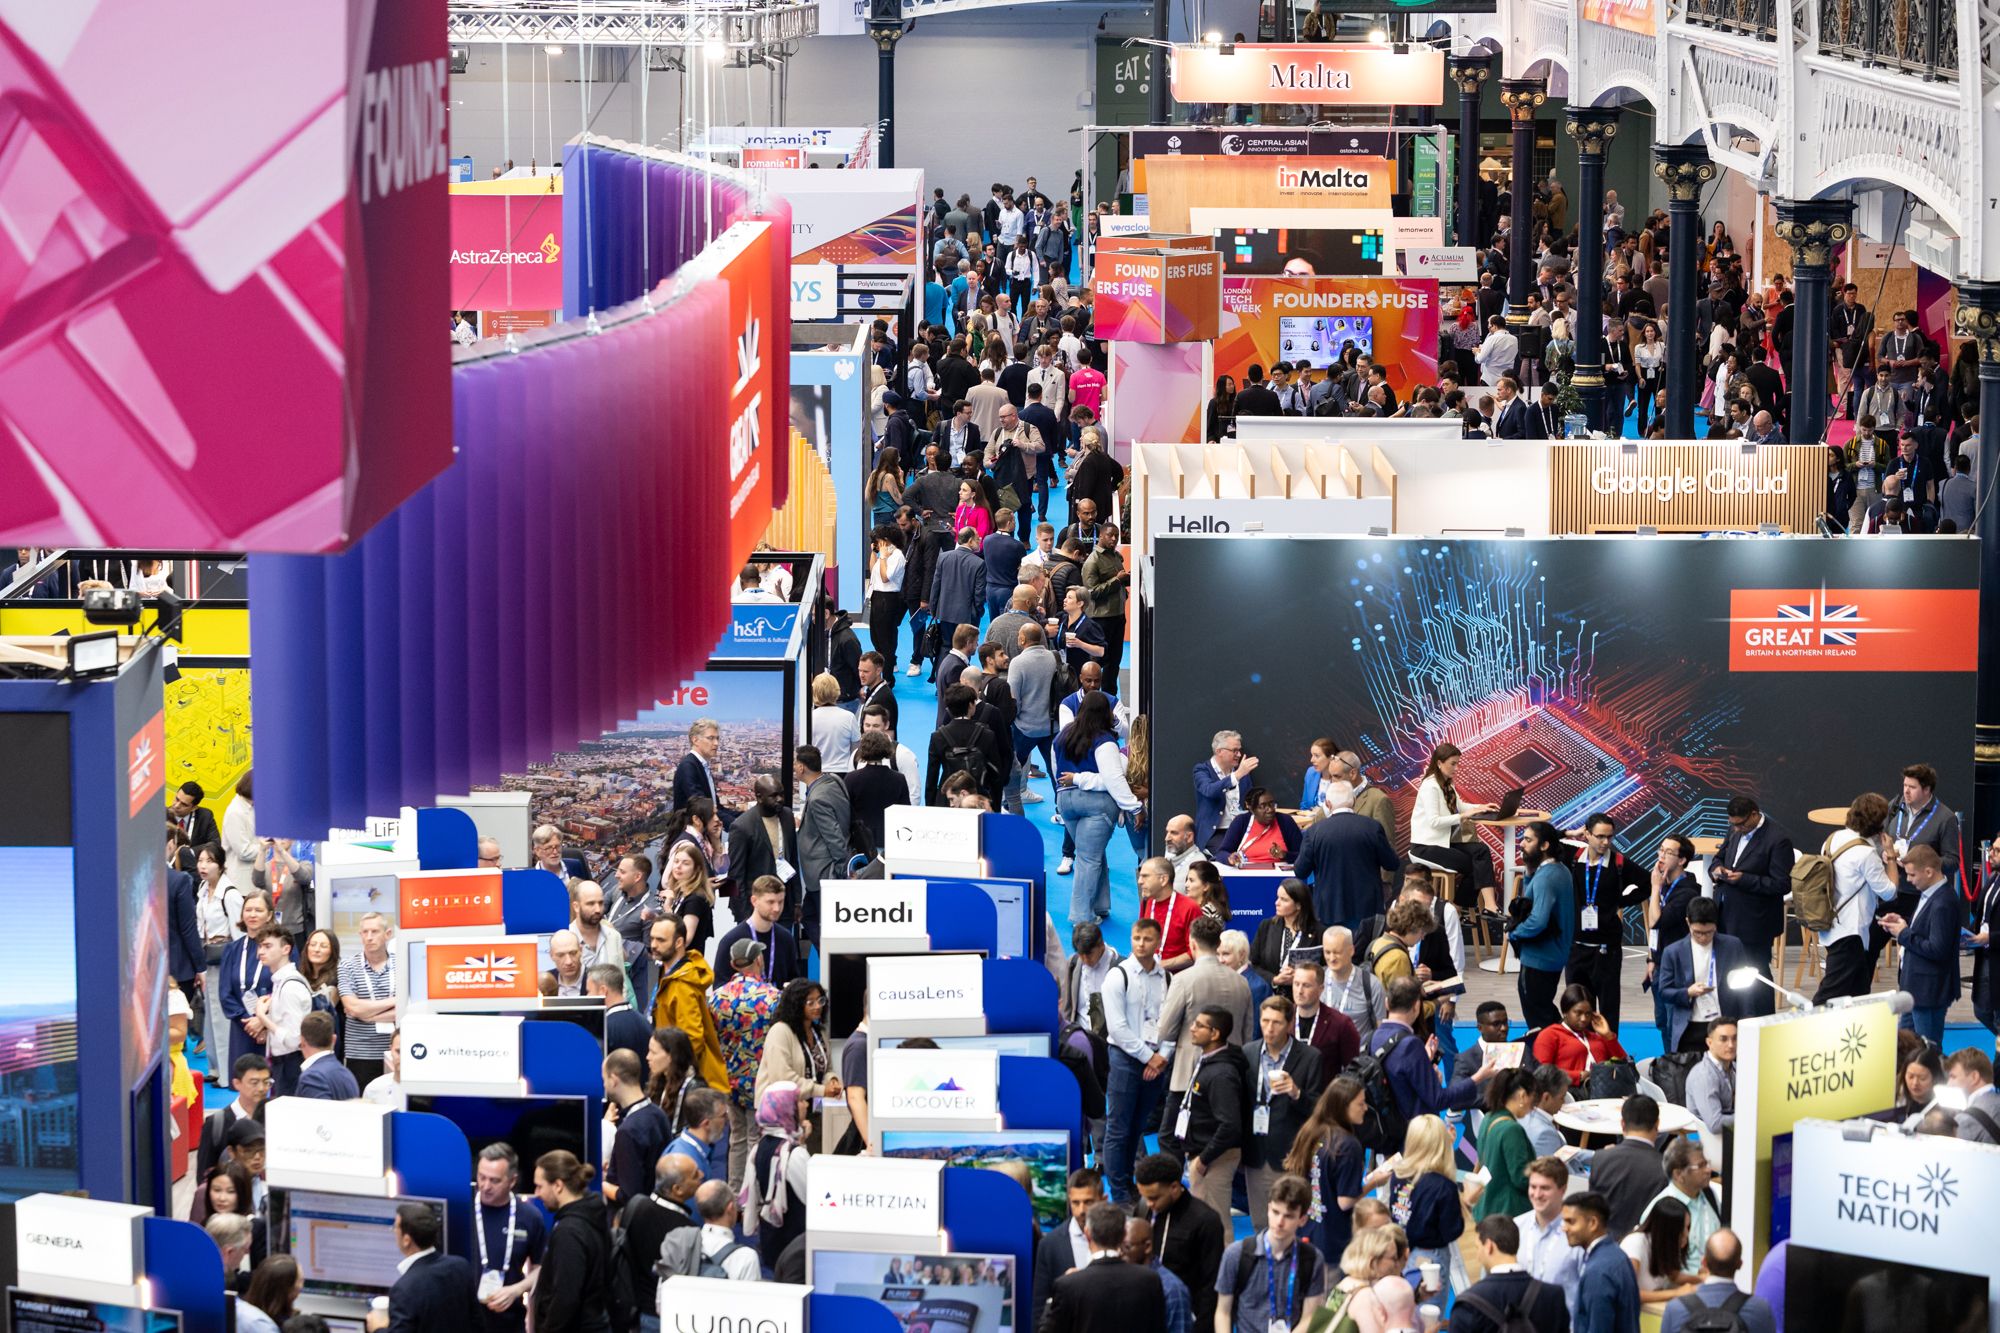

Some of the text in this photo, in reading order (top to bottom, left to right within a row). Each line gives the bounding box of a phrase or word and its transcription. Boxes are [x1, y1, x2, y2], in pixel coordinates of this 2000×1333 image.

[1115, 55, 1140, 81] EAT
[1270, 63, 1351, 89] Malta
[1799, 132, 1807, 142] 6
[1279, 167, 1368, 188] inMalta
[1989, 197, 1998, 210] 7
[449, 249, 543, 264] AstraZeneca
[1115, 263, 1160, 279] FOUND
[1167, 262, 1213, 279] ERS FUSE
[790, 280, 822, 303] YS
[857, 280, 898, 288] PolyVentures
[1096, 281, 1153, 297] ERS FUSE
[1223, 295, 1253, 304] TECH
[1273, 292, 1429, 309] FOUNDERS FUSE
[1231, 304, 1262, 313] WEEK
[1591, 466, 1788, 502] Google Cloud
[1168, 515, 1230, 533] Hello
[733, 620, 766, 637] h&f
[1745, 628, 1814, 646] GREAT
[835, 901, 913, 923] bendi
[445, 970, 489, 983] GREAT
[878, 986, 964, 1001] causaLens
[437, 1046, 510, 1061] whitespace
[1788, 1050, 1836, 1078] TECH
[1786, 1069, 1855, 1101] NATION
[891, 1095, 976, 1109] DXCOVER
[1838, 1173, 1910, 1204] TECH
[842, 1192, 927, 1210] HERTZIAN
[1837, 1198, 1939, 1235] NATION
[51, 1304, 90, 1318] MARKET
